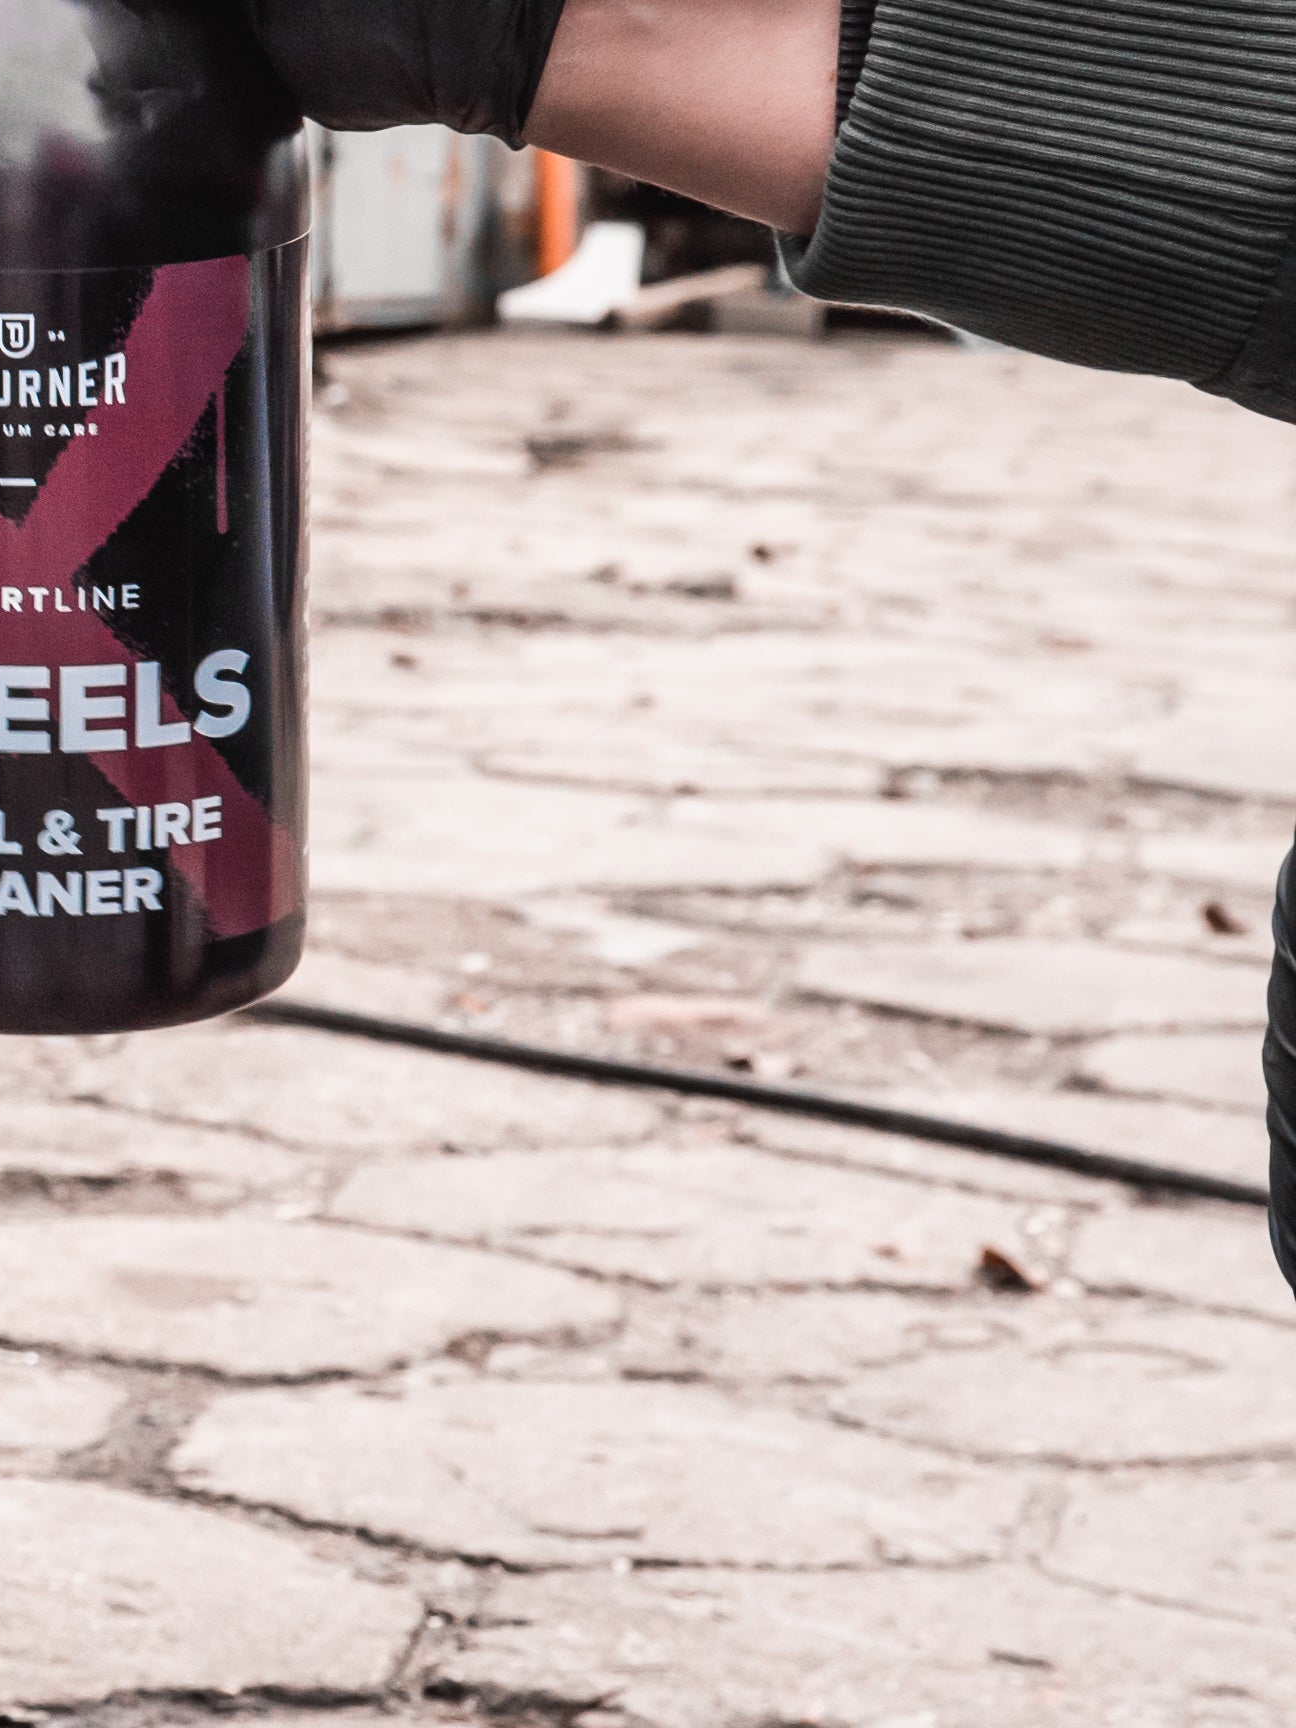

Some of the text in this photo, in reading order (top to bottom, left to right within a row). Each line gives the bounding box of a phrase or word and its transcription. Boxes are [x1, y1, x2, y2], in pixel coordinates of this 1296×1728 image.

[43, 422, 100, 438] CARE
[37, 808, 83, 855] &
[96, 796, 223, 855] TIRE
